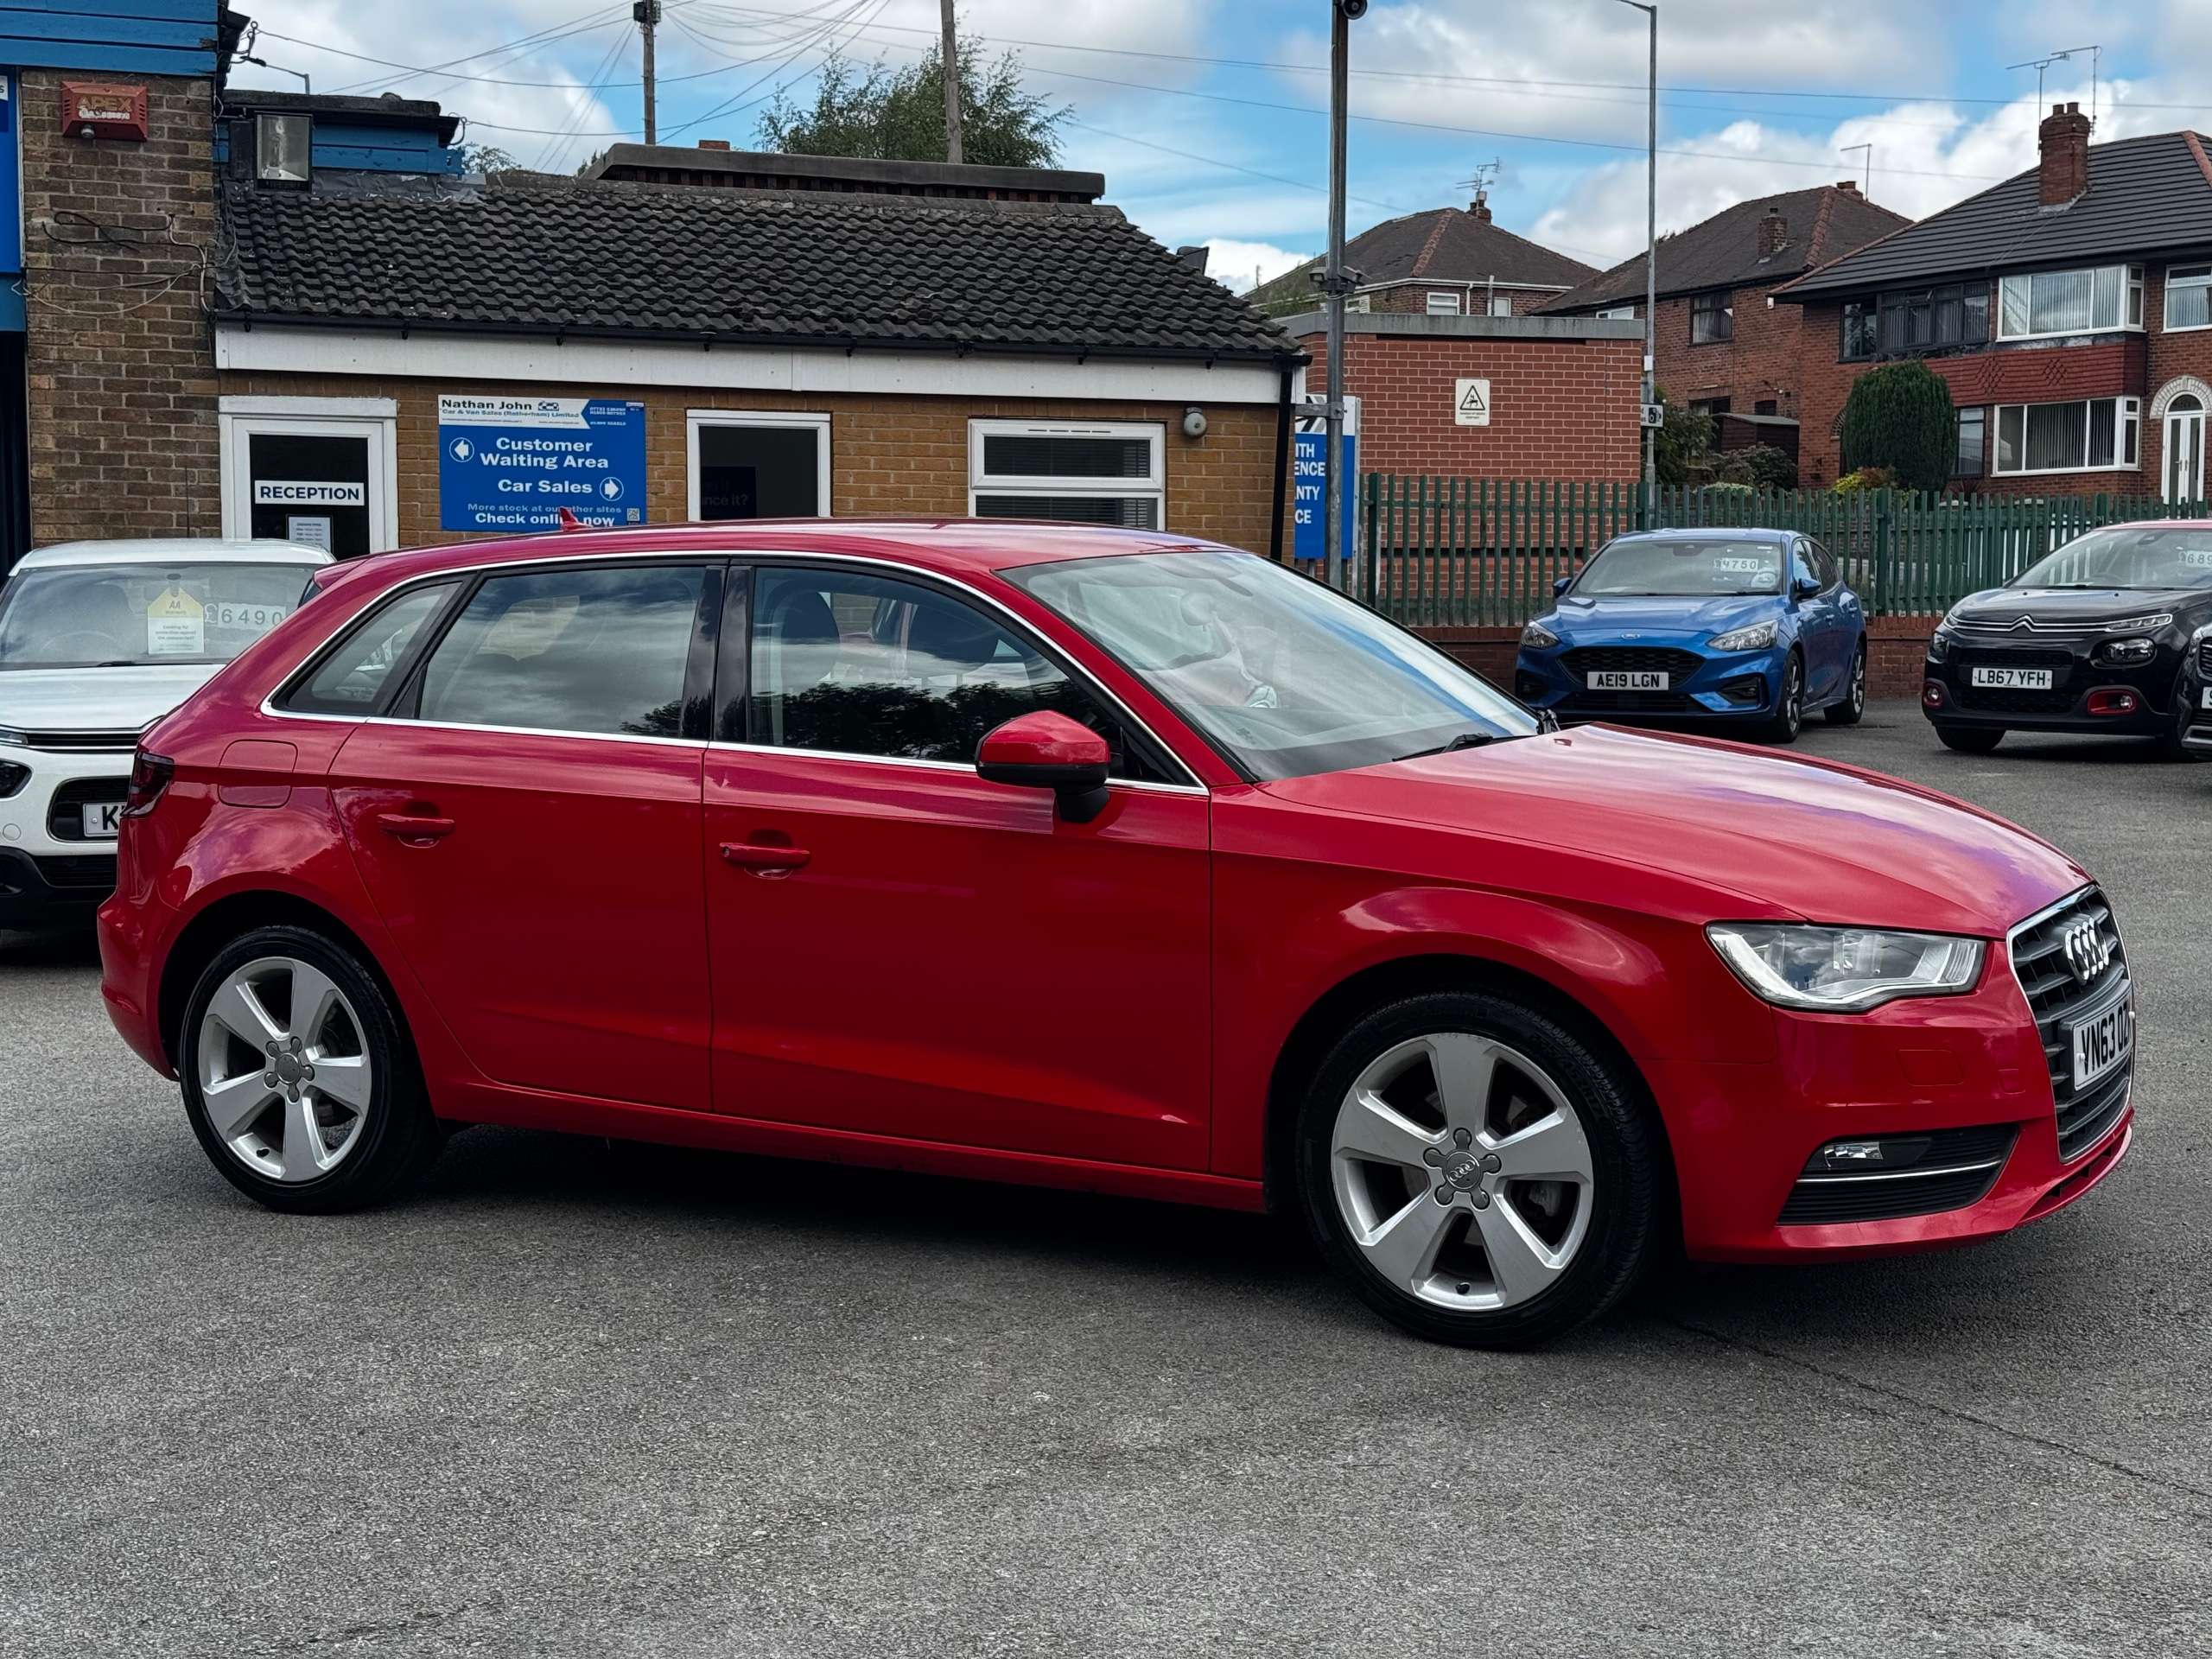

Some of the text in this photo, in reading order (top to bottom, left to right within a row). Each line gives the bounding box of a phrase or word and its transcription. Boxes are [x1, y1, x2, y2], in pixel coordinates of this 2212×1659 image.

[77, 96, 132, 111] APEX
[442, 399, 532, 410] Nathan John
[496, 437, 593, 452] Customer
[480, 453, 609, 470] Waiting Area
[260, 486, 359, 500] RECEPTION
[498, 479, 593, 493] Car Sales
[1295, 486, 1320, 500] NTY
[467, 503, 496, 512] More
[498, 504, 529, 512] stock
[475, 512, 614, 526] Check onli now
[168, 601, 181, 609] AA
[1596, 673, 1660, 688] AE19 LGN
[1978, 669, 2046, 686] LB67 YFH
[102, 805, 126, 830] K
[2082, 999, 2131, 1076] VN63 OZ
